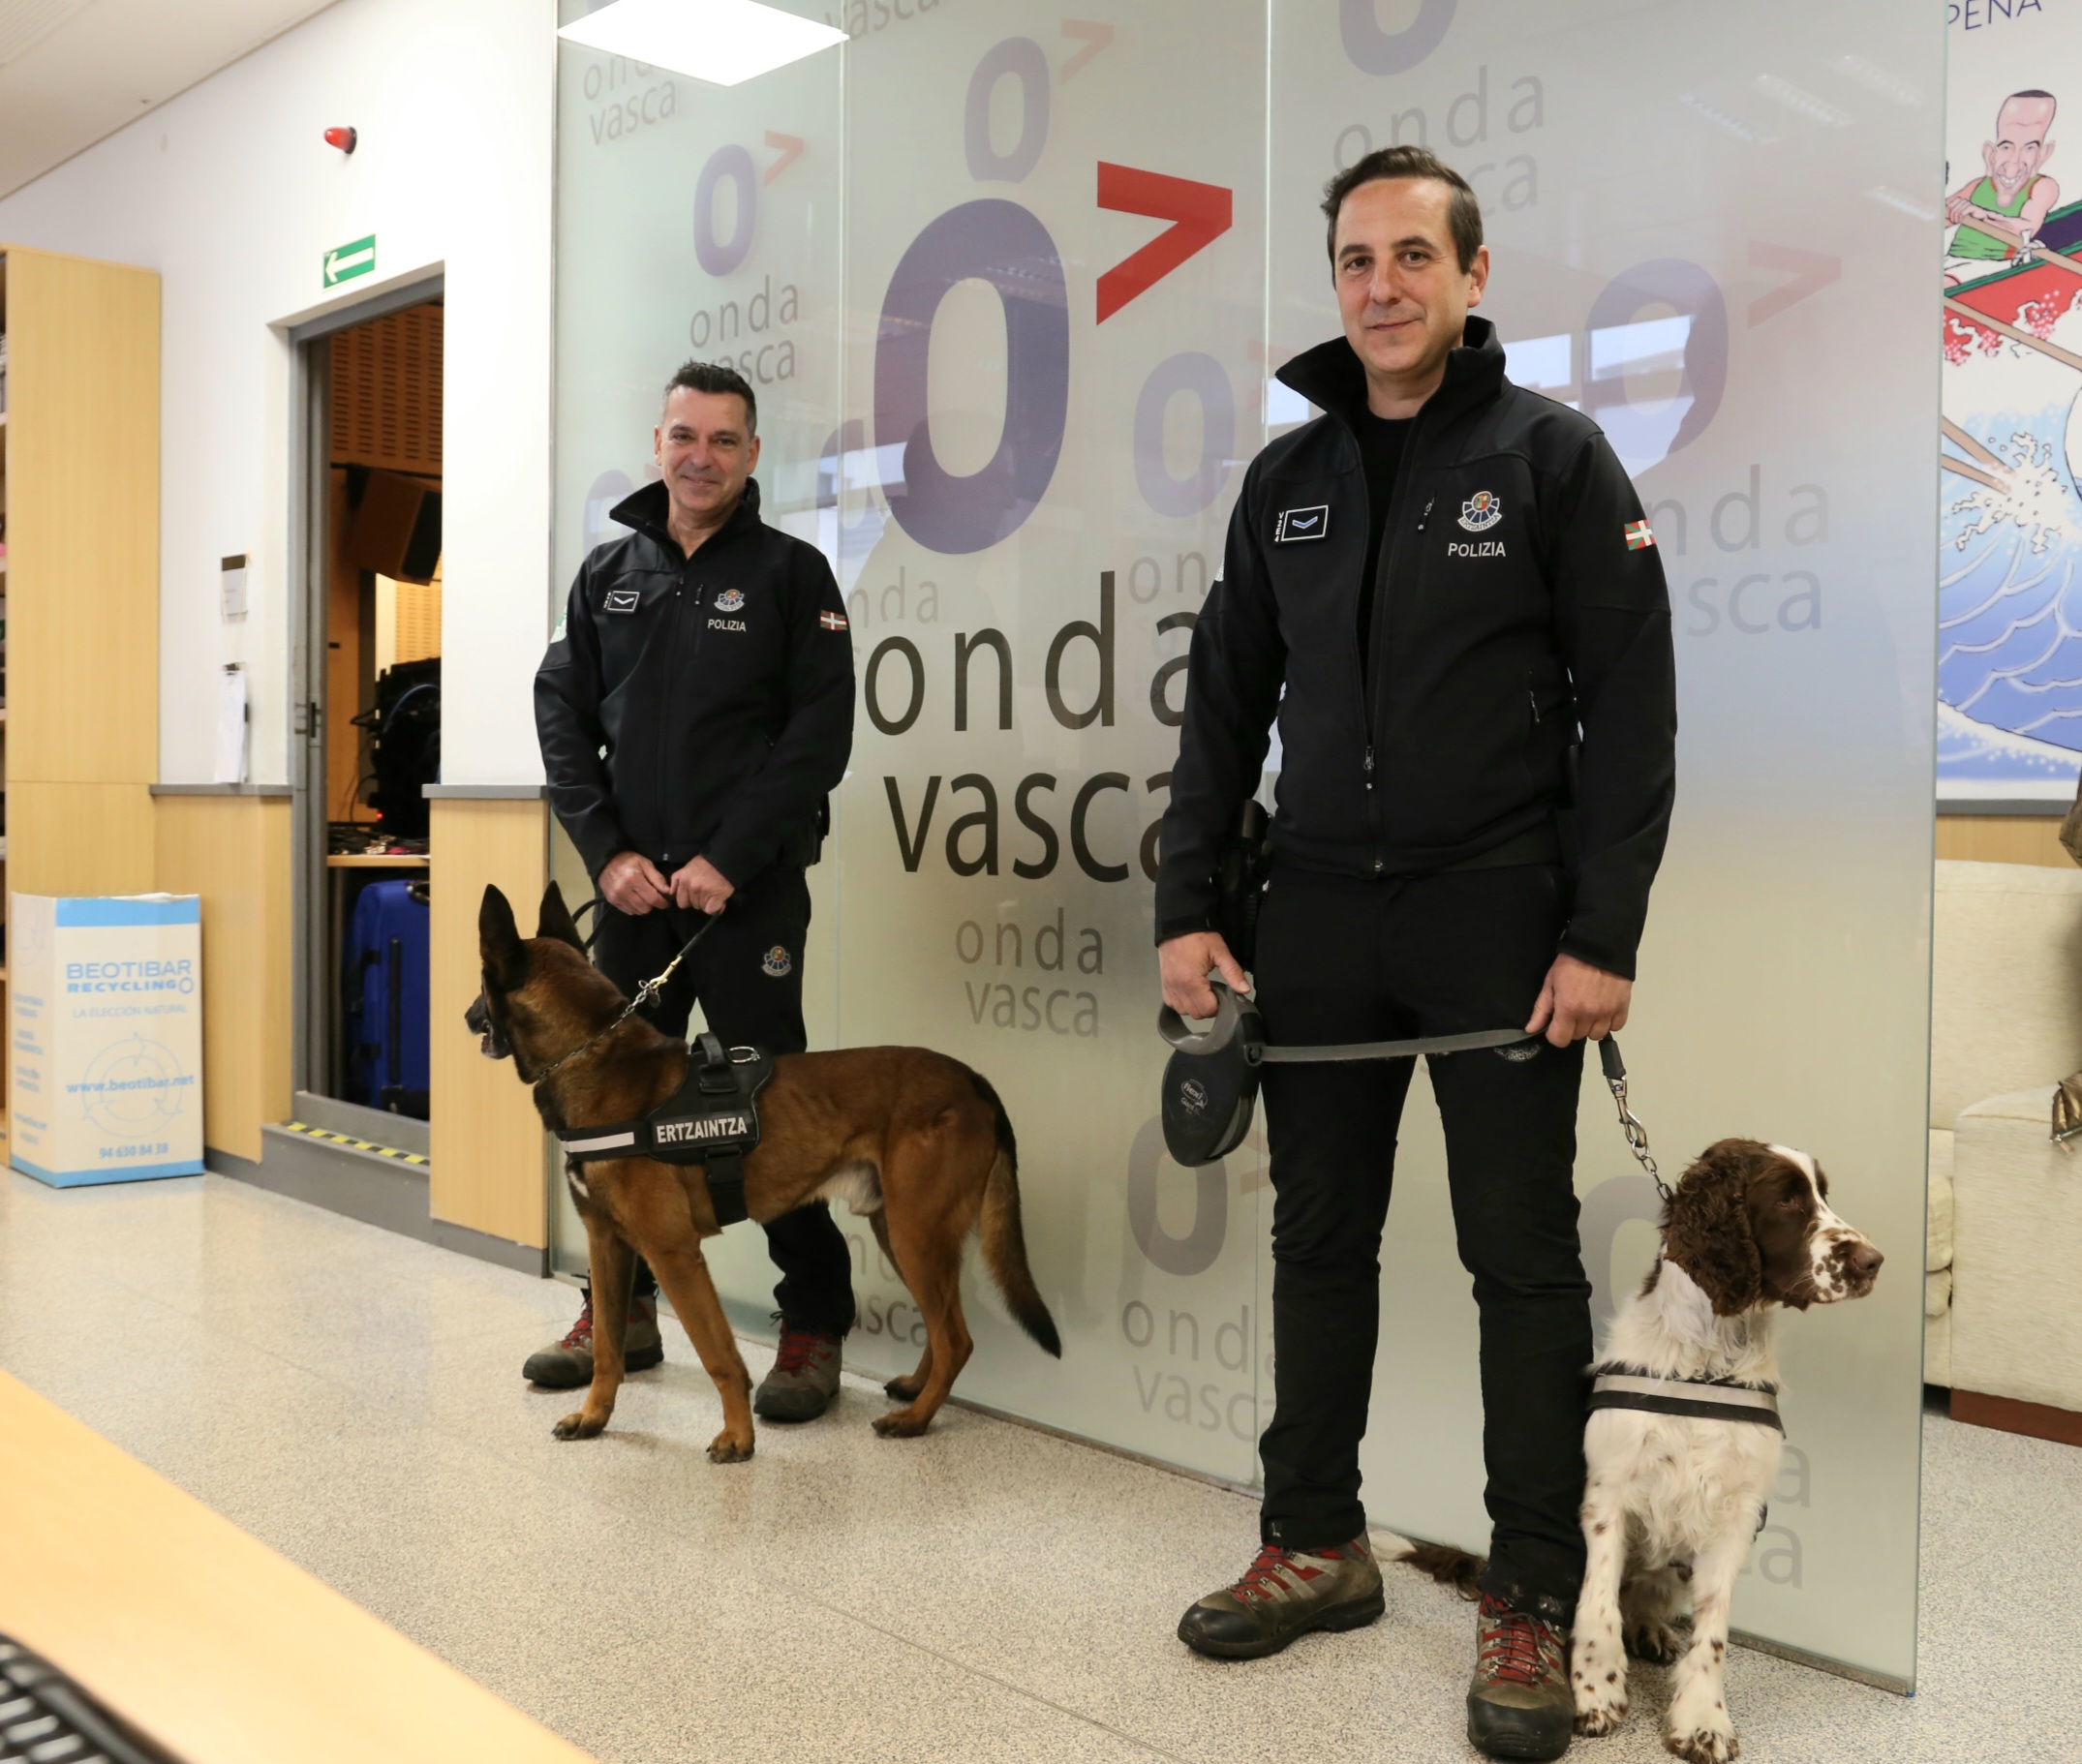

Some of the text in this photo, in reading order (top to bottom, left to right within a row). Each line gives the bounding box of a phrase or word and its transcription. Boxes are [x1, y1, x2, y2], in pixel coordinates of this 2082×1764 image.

[590, 80, 676, 145] vasca
[690, 274, 798, 349] onda
[1448, 541, 1507, 557] POLIZIA
[708, 619, 747, 631] POLIZIA
[956, 907, 1103, 975] onda
[66, 959, 192, 980] BEOTIBAR
[67, 980, 176, 992] RECYCLING
[73, 1003, 188, 1019] LA ELECCIÓN NATURAL
[964, 981, 1099, 1038] vasca
[66, 1075, 195, 1092] www.beotibar.net
[657, 1116, 748, 1142] ERTZAINTZA
